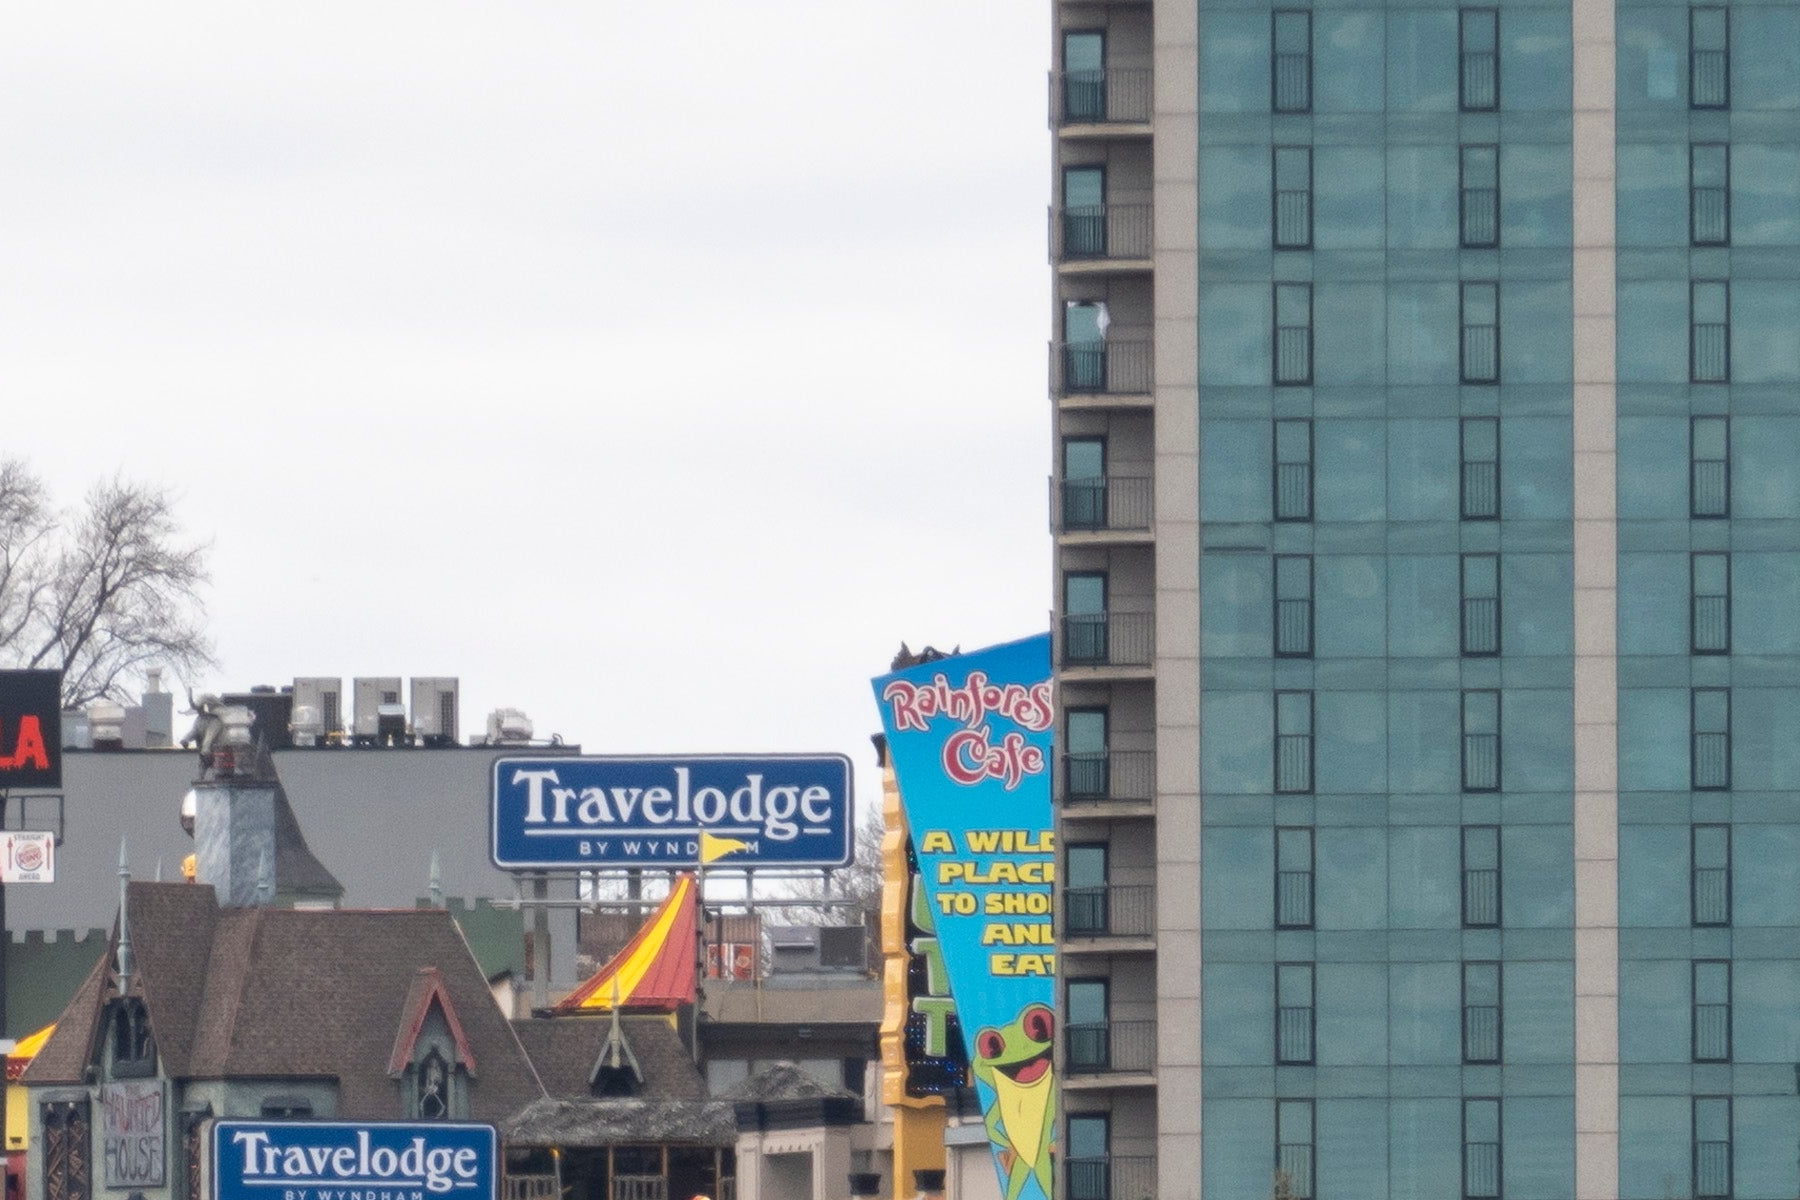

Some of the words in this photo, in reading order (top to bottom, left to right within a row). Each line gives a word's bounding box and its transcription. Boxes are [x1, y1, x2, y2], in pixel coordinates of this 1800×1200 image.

[884, 671, 1054, 731] Rainfores
[943, 726, 1044, 790] Cafe
[512, 767, 832, 840] Travelodge
[580, 841, 608, 855] BY
[624, 841, 760, 855] WYNDM
[923, 831, 954, 852] A
[938, 893, 978, 914] TO
[985, 892, 1052, 914] SHO
[105, 1136, 161, 1182] HOUSE
[233, 1131, 478, 1192] Travelodge
